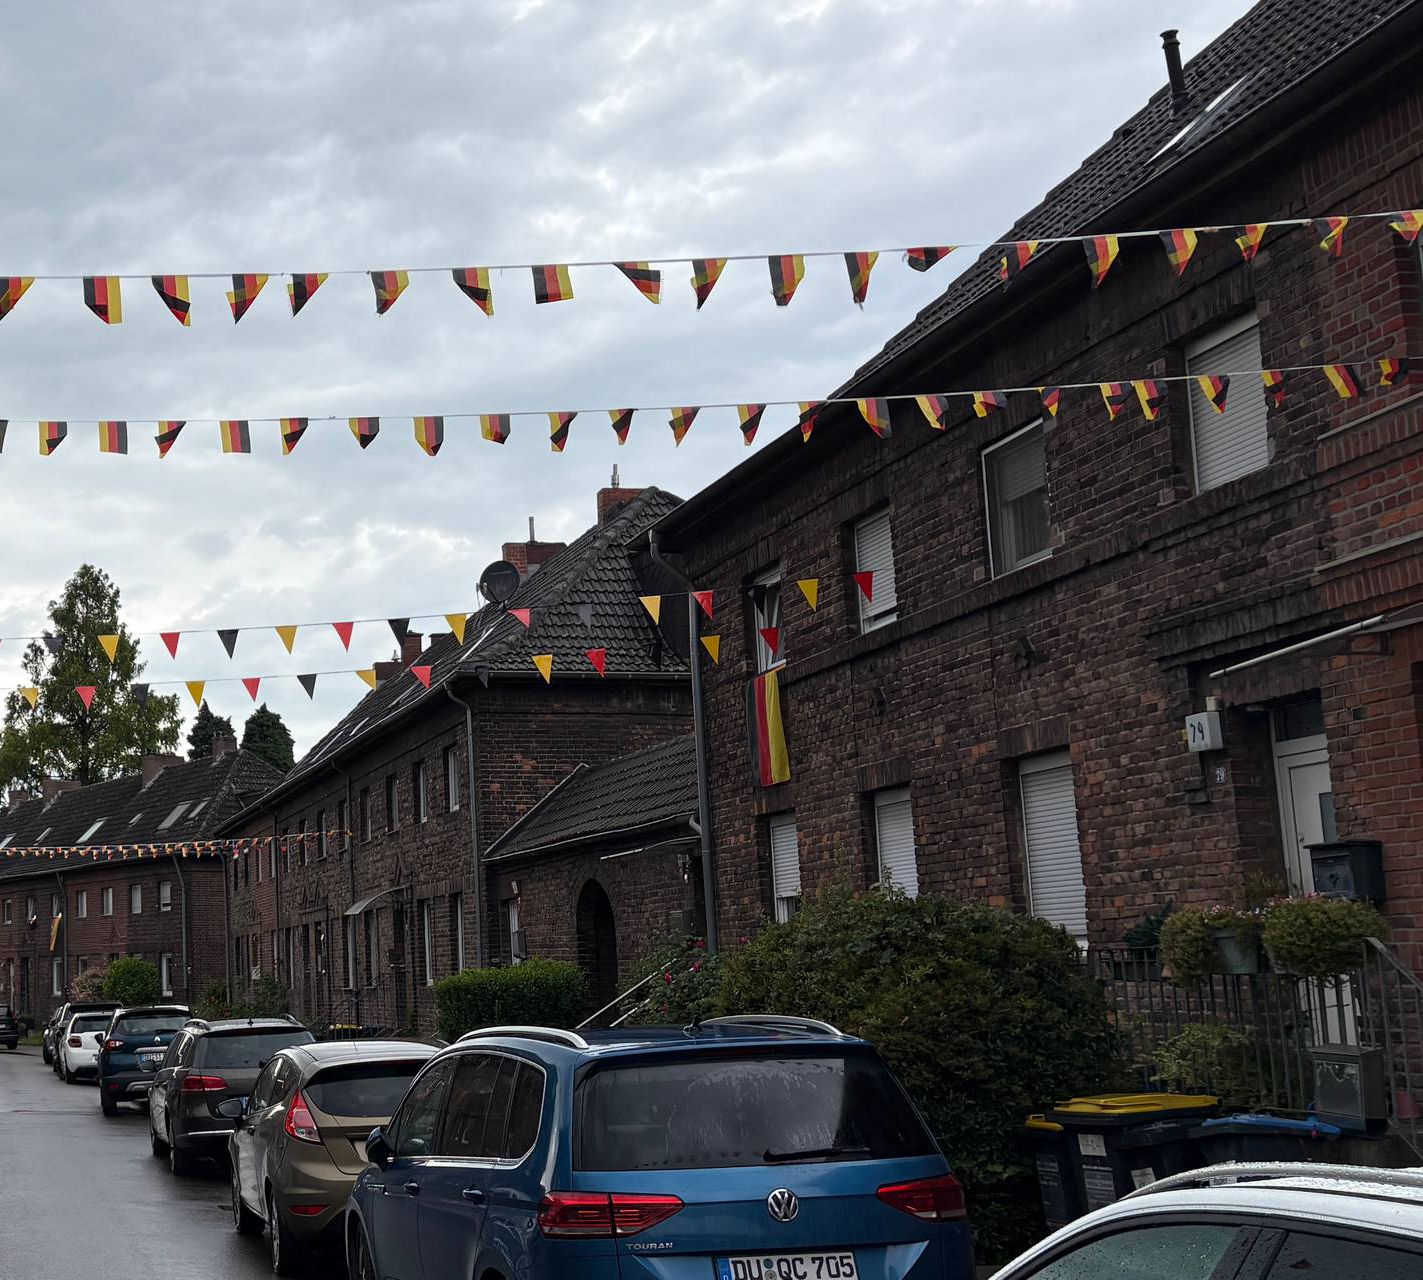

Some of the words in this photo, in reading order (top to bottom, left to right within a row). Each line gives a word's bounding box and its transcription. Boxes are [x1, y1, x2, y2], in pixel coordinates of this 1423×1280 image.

[1190, 721, 1205, 744] 79
[626, 1242, 674, 1250] TOURAN
[731, 1259, 765, 1280] DU
[776, 1257, 809, 1280] QC
[810, 1255, 855, 1279] 705
